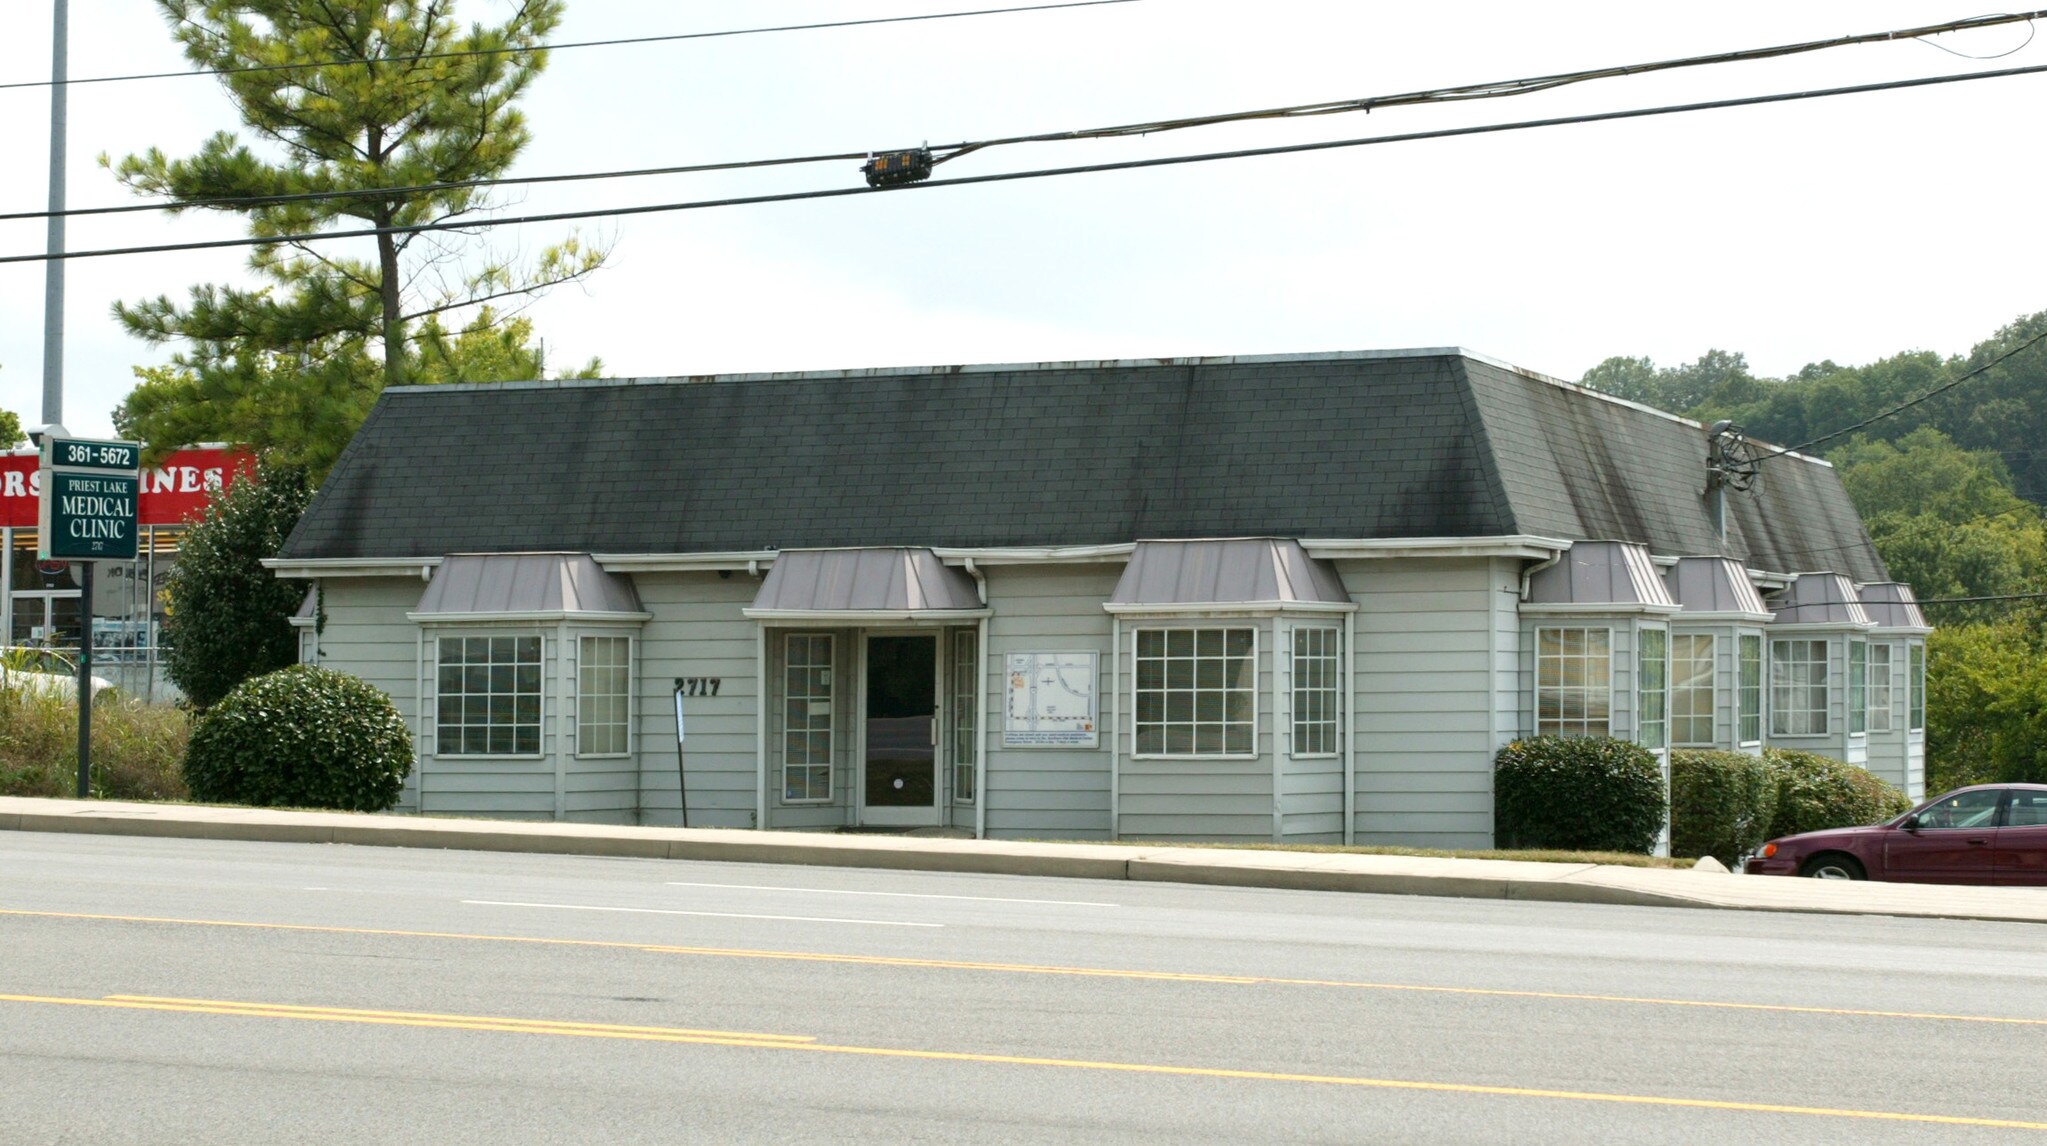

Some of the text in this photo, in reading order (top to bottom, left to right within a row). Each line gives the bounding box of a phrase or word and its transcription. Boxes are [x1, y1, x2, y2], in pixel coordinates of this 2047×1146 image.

[68, 445, 130, 465] 361-5672
[0, 470, 39, 497] RS
[69, 480, 128, 493] PRIEST LAKE
[62, 495, 134, 517] MEDICAL
[70, 518, 125, 539] CLINIC
[674, 677, 721, 696] 2717
